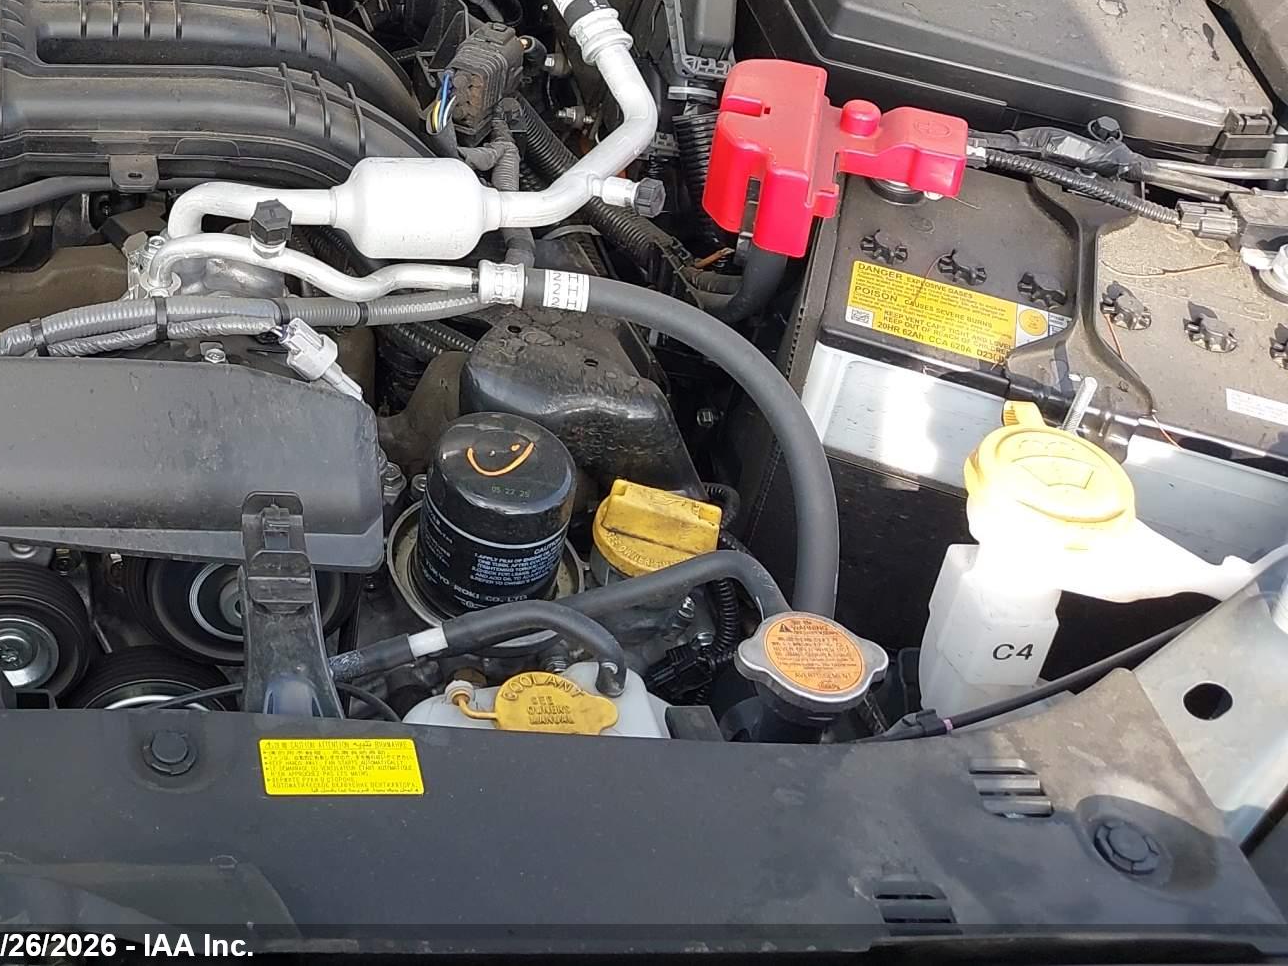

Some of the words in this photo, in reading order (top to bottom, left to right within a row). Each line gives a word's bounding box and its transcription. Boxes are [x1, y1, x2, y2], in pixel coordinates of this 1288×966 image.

[858, 263, 903, 280] DANGER
[855, 286, 898, 302] POISON
[904, 299, 934, 312] CAUSES
[936, 307, 966, 320] SEVERE
[929, 335, 949, 347] CCA
[992, 643, 1034, 661] C4
[501, 673, 585, 701] COOLANT
